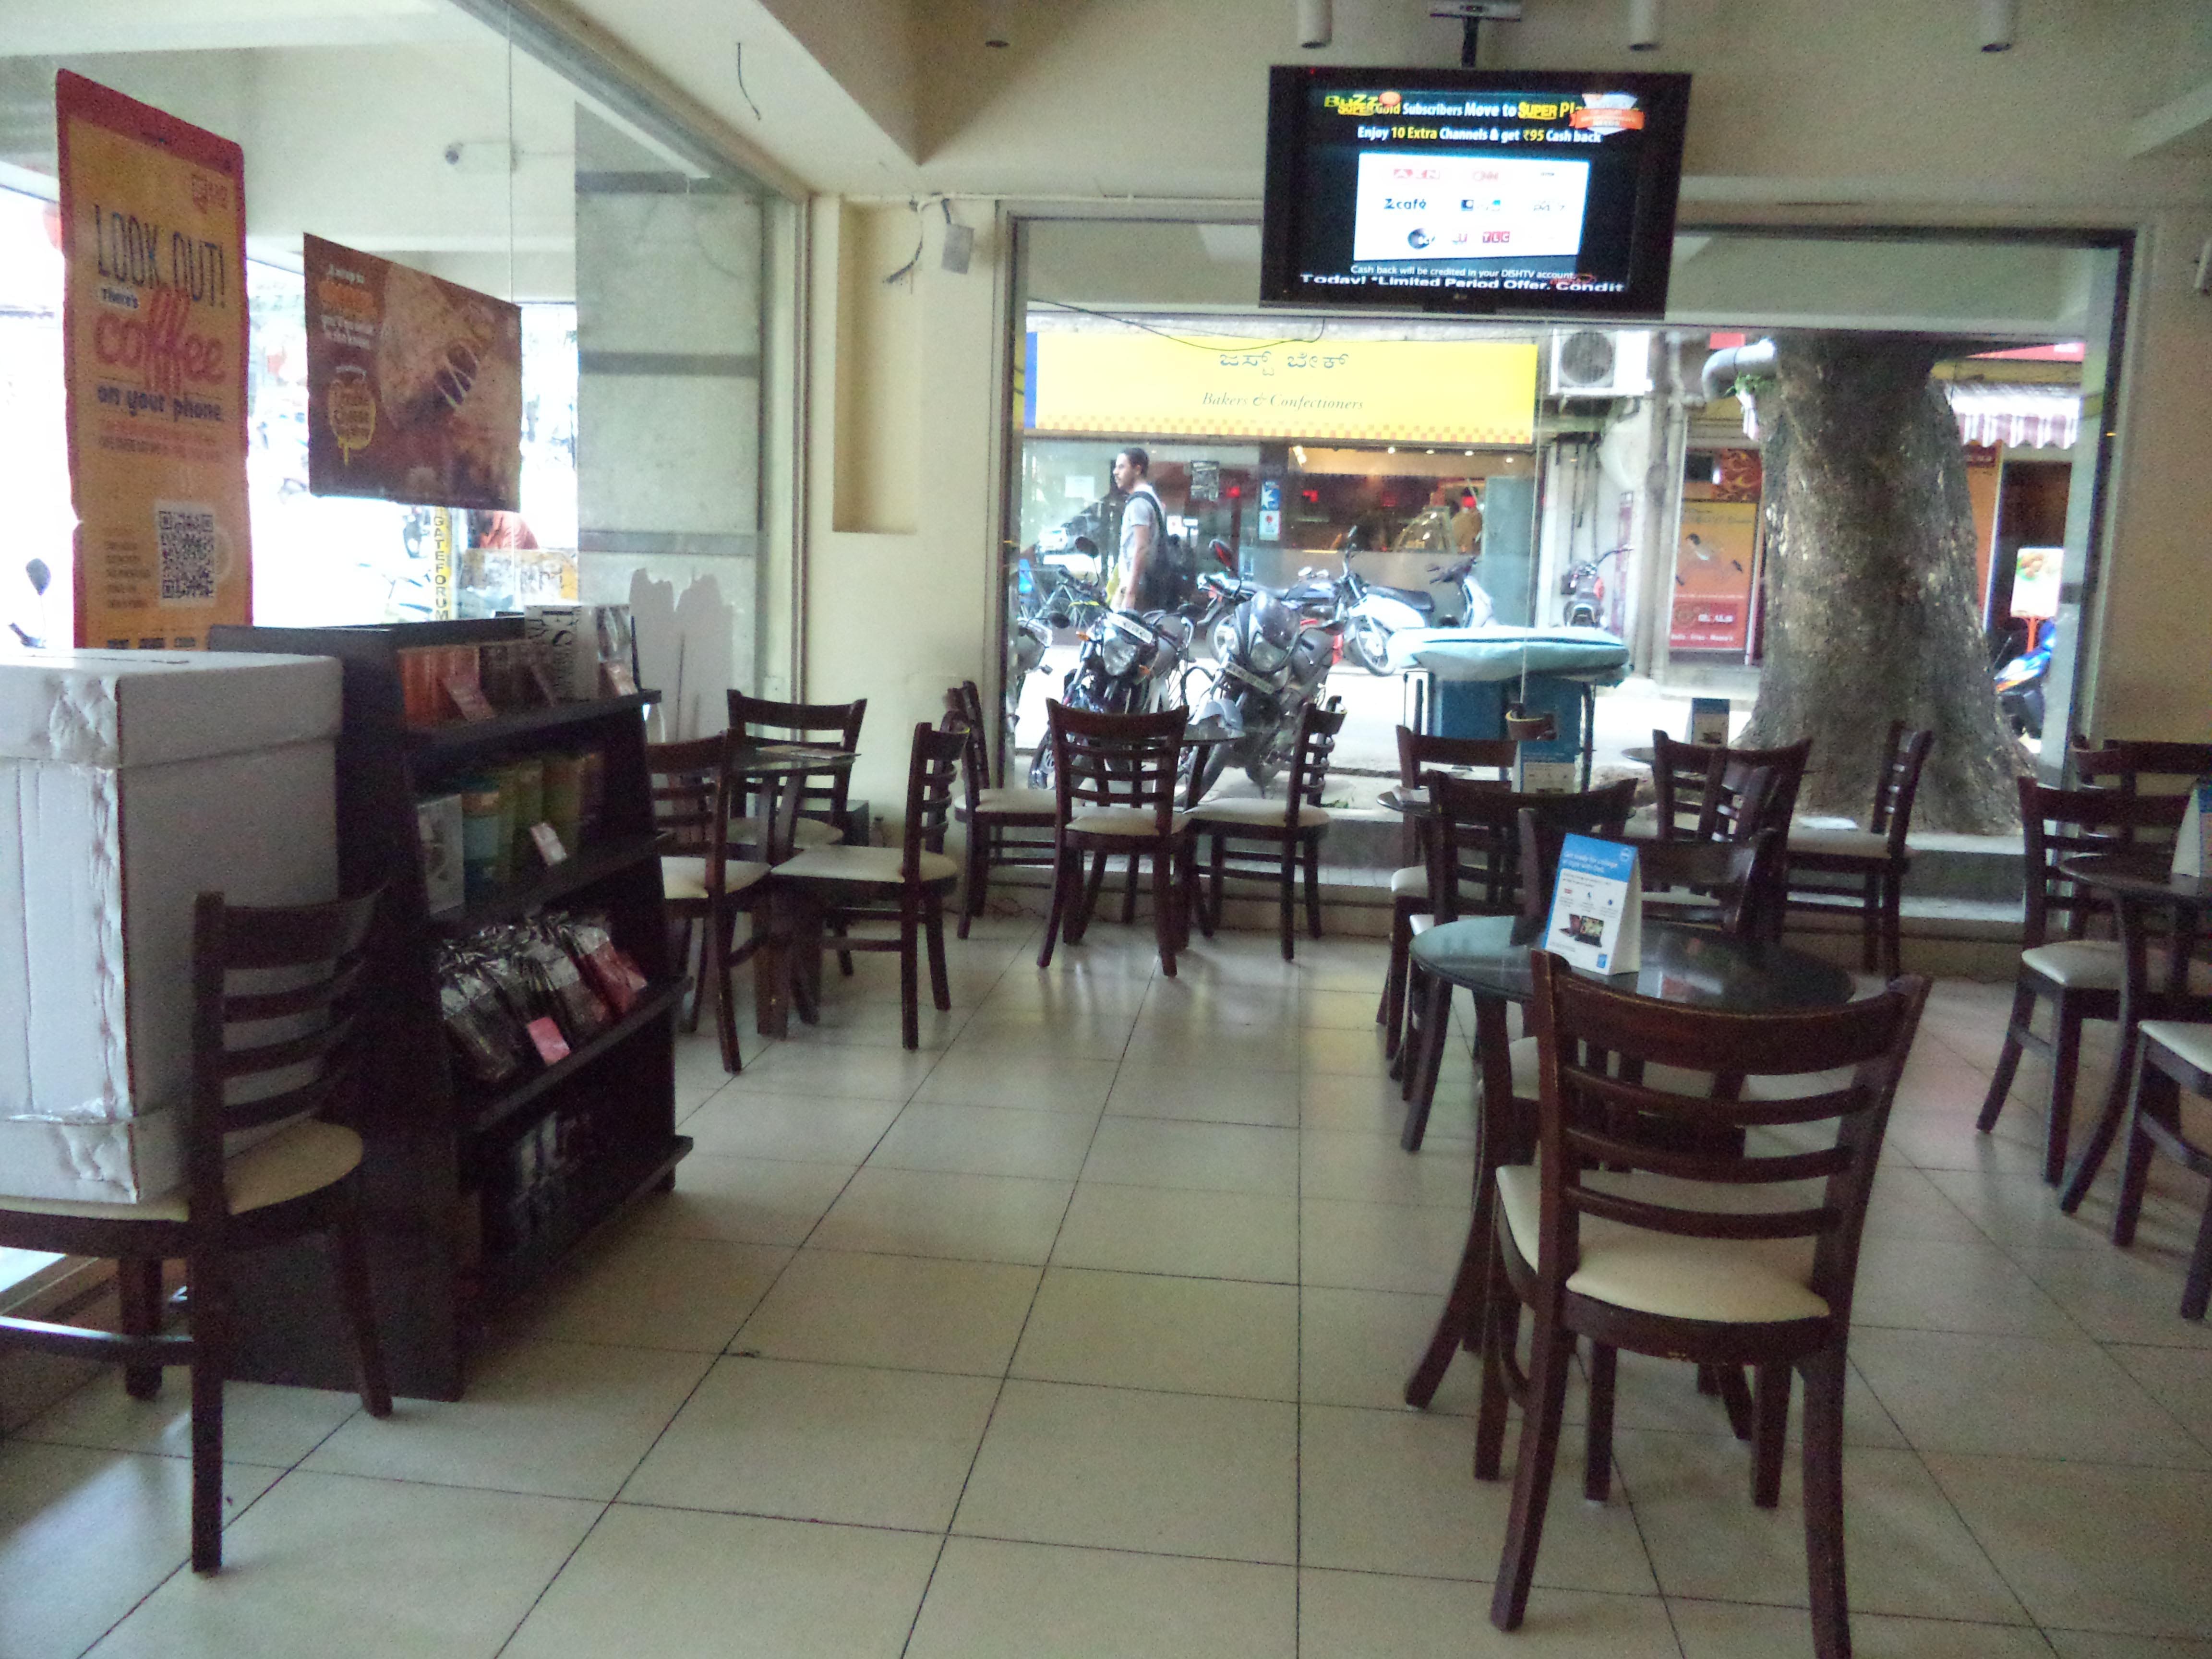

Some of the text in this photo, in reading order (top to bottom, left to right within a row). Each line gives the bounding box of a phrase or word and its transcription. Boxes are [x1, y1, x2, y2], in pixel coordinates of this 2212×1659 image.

[1403, 102, 1463, 116] Subscribers
[1465, 102, 1500, 117] Move
[1502, 103, 1517, 117] to
[1518, 101, 1557, 120] SUPER
[1358, 126, 1389, 141] Enjoy
[1392, 127, 1406, 139] 10
[1407, 127, 1438, 140] Extra
[1439, 127, 1488, 141] Channels
[1490, 128, 1499, 141] &
[1501, 130, 1520, 144] get
[1546, 129, 1571, 142] Cash
[1574, 130, 1602, 143] back
[94, 204, 161, 289] LOOK
[1350, 265, 1375, 274] Cash
[1377, 266, 1397, 275] back
[1399, 266, 1415, 275] will
[1417, 267, 1428, 276] be
[1430, 268, 1466, 276] credited
[1444, 278, 1499, 289] Period
[1503, 279, 1551, 290] Offer.
[1555, 282, 1624, 292] Condit
[95, 283, 227, 395] coffee
[97, 385, 120, 406] on
[127, 390, 166, 417] your
[1202, 392, 1365, 411] Bakers & Confectioners
[434, 516, 449, 621] GATEFORUM
